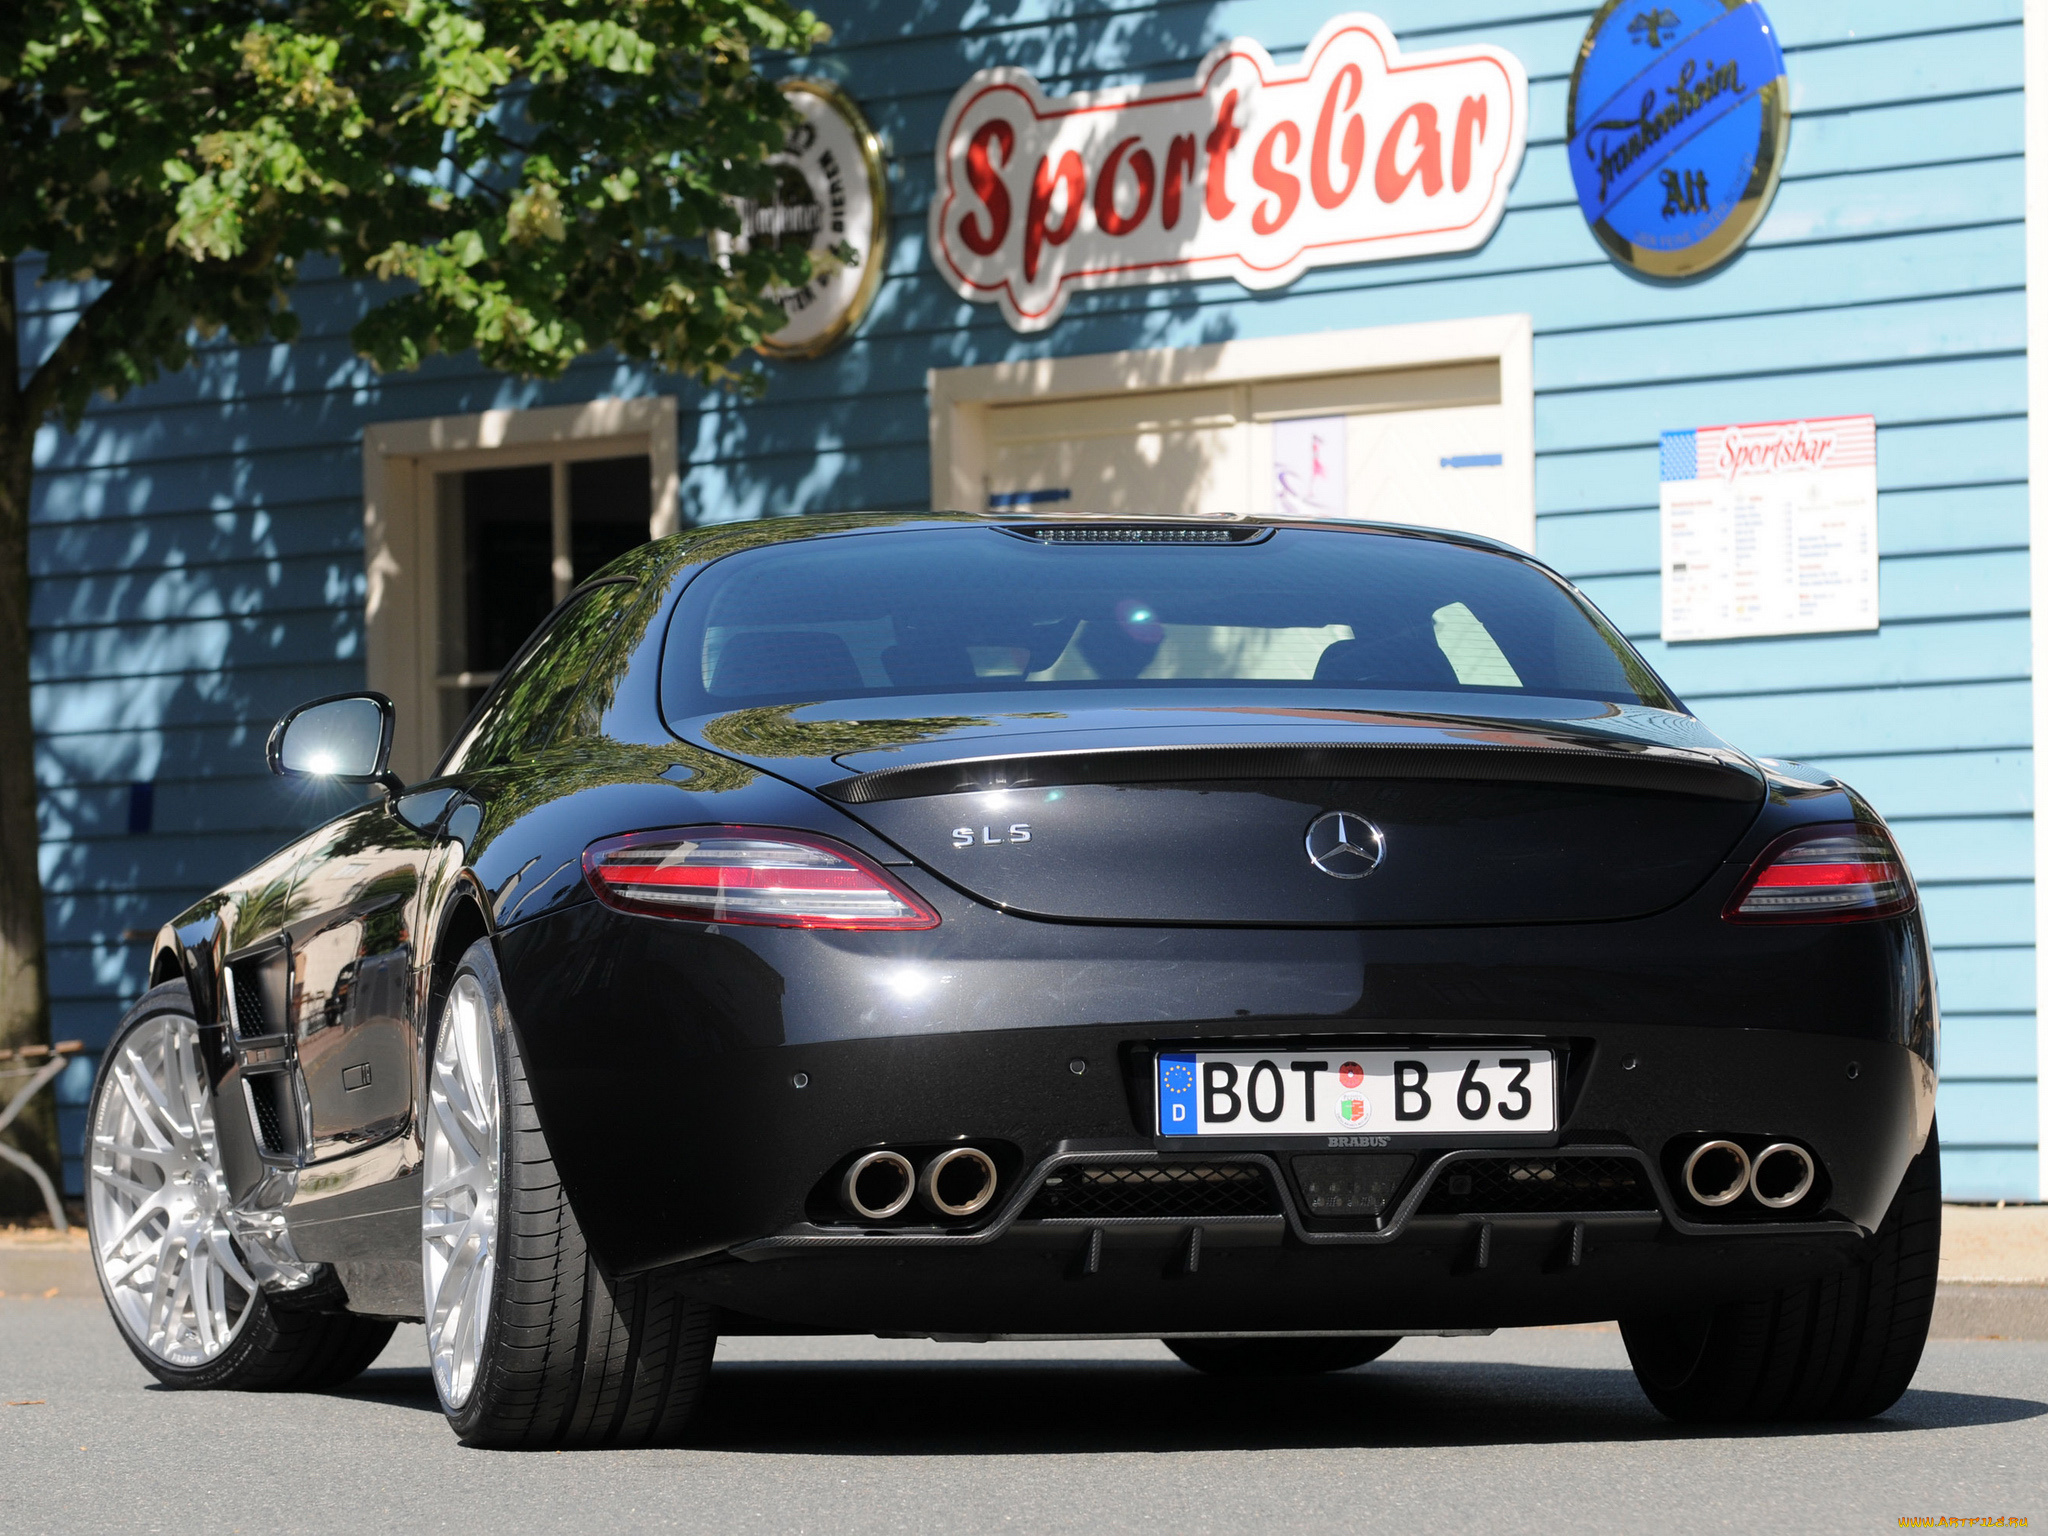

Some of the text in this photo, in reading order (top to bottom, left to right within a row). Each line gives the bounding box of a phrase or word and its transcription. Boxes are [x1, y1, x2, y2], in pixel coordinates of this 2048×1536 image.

[958, 62, 1488, 284] Sportsbar
[1659, 168, 1710, 222] Alt
[1719, 430, 1832, 482] Sportsbar
[952, 823, 1032, 848] SLS
[1172, 1103, 1186, 1122] D
[1203, 1059, 1532, 1123] BOT B 63
